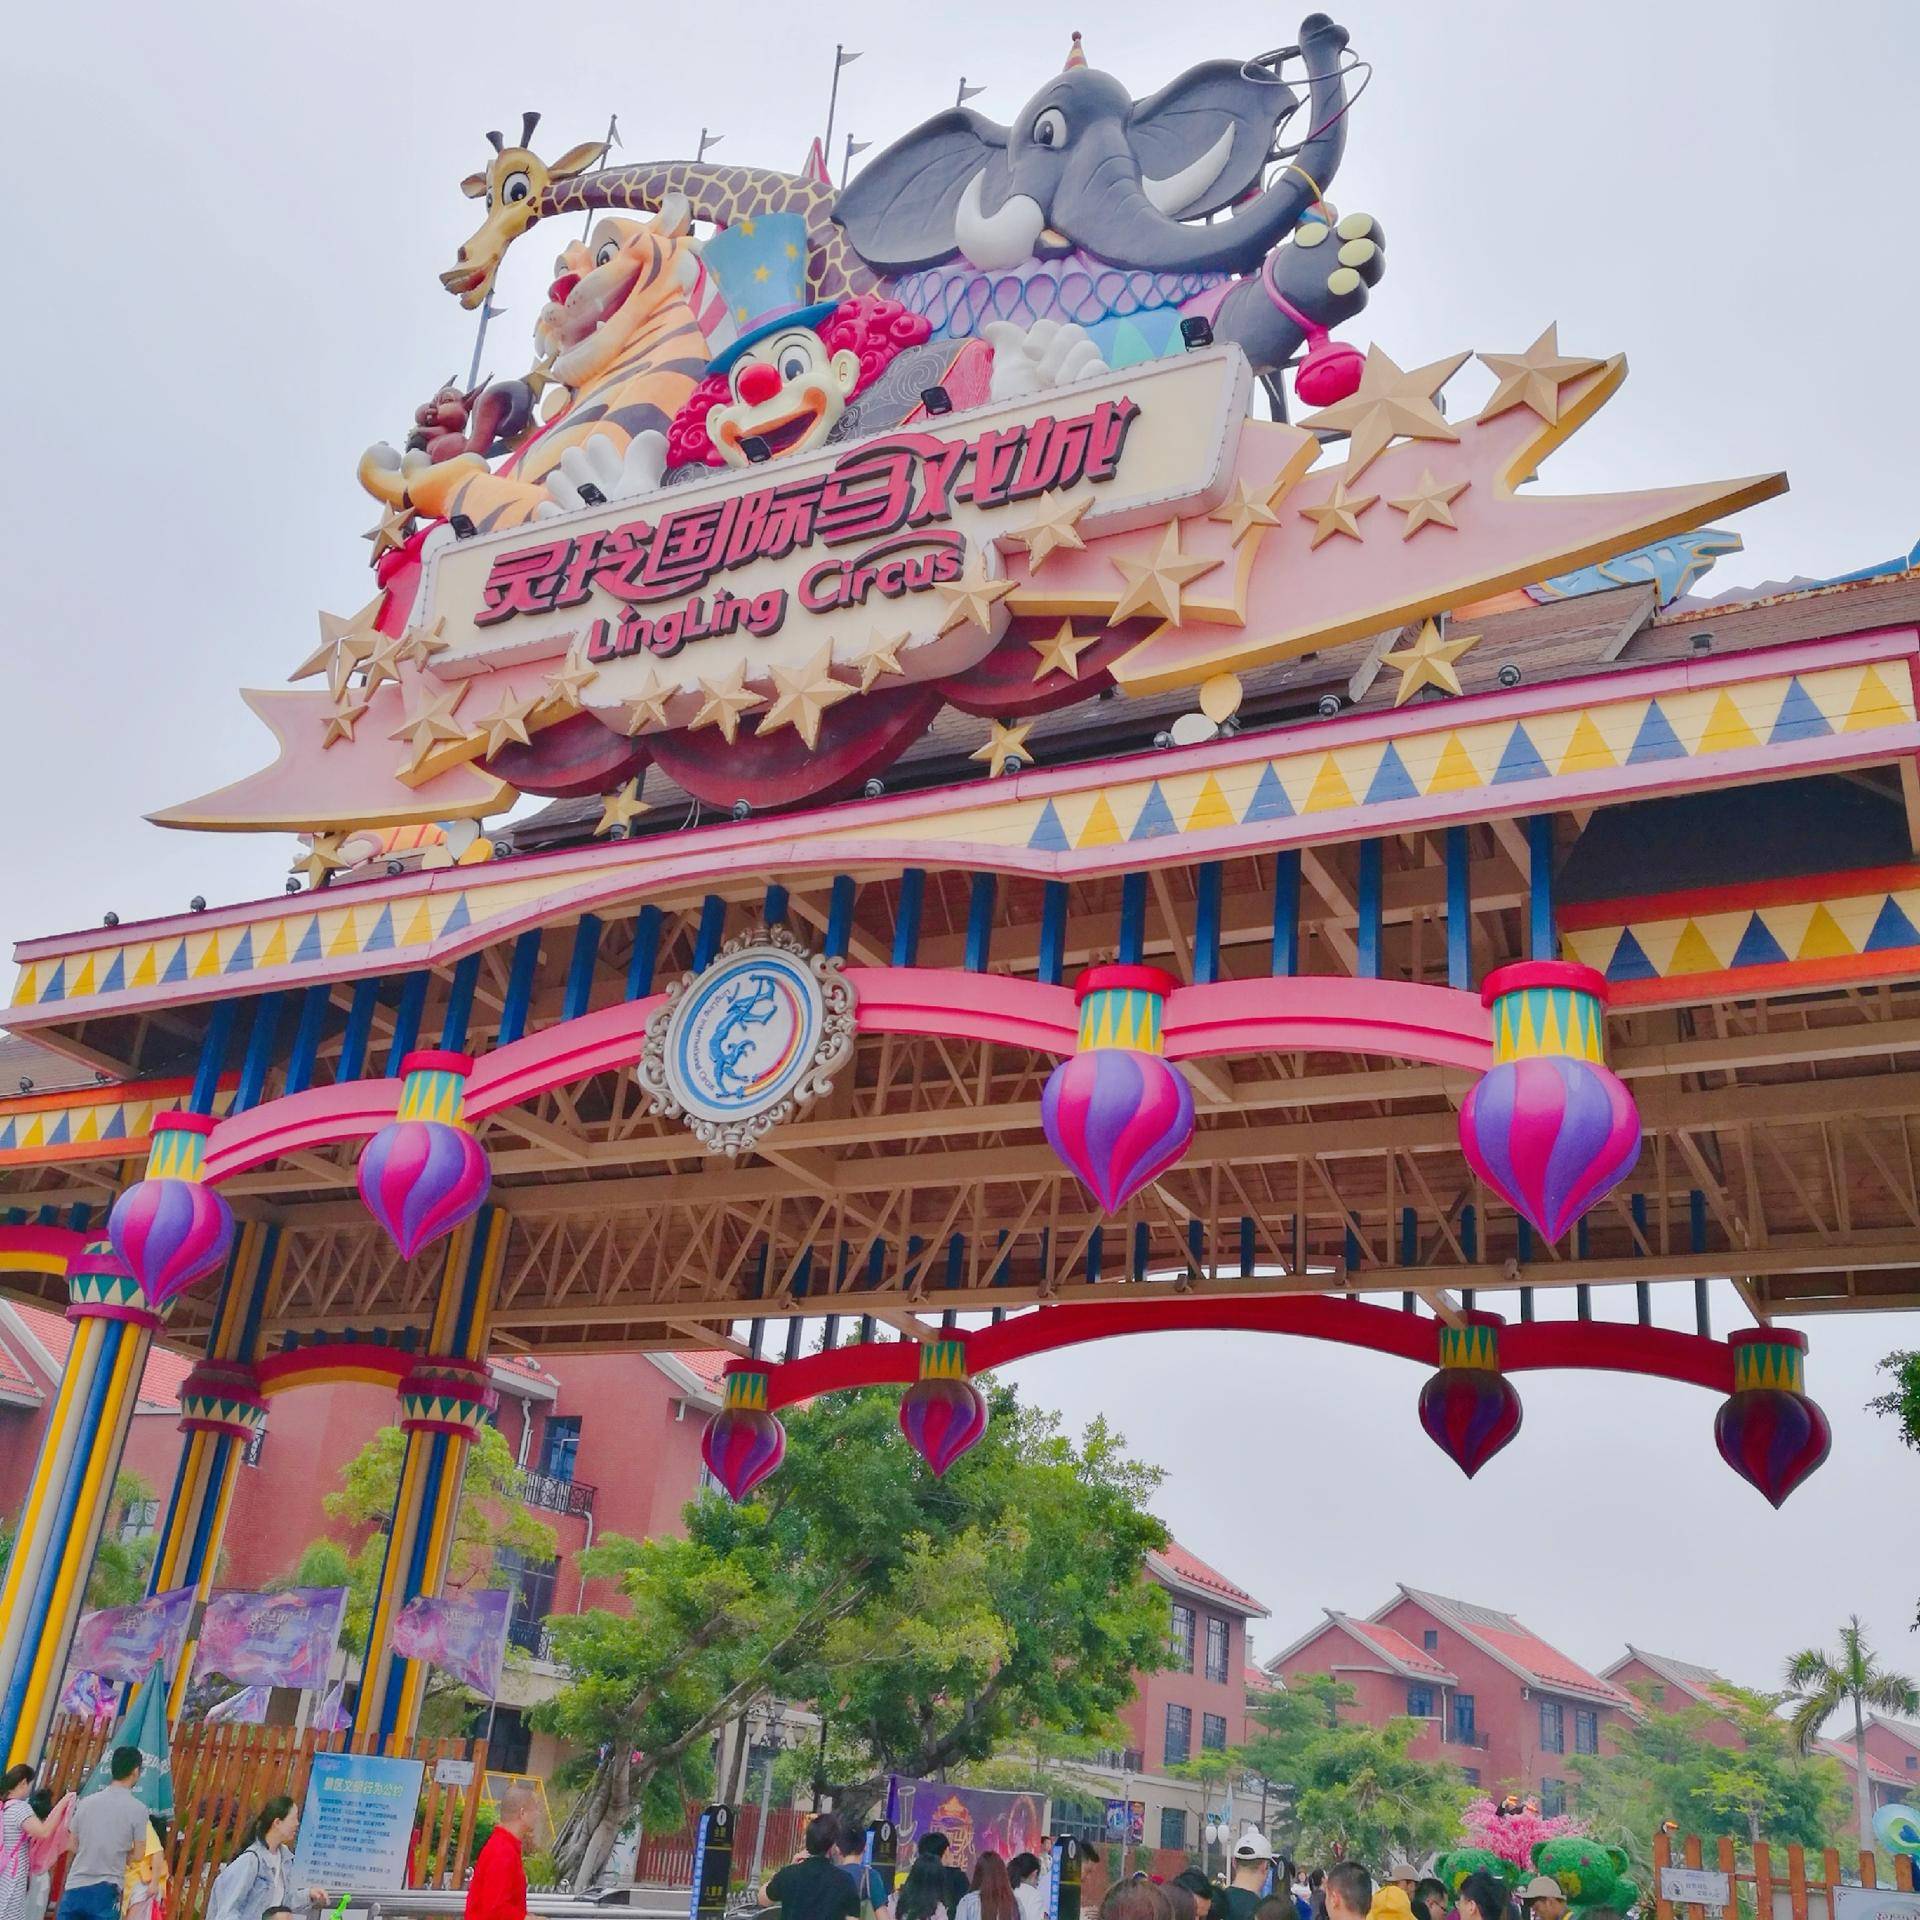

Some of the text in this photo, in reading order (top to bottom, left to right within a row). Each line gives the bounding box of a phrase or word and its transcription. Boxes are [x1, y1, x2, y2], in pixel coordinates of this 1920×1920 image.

[474, 395, 1141, 627] 灵玲国际马戏城
[587, 529, 967, 663] LingLing Circus
